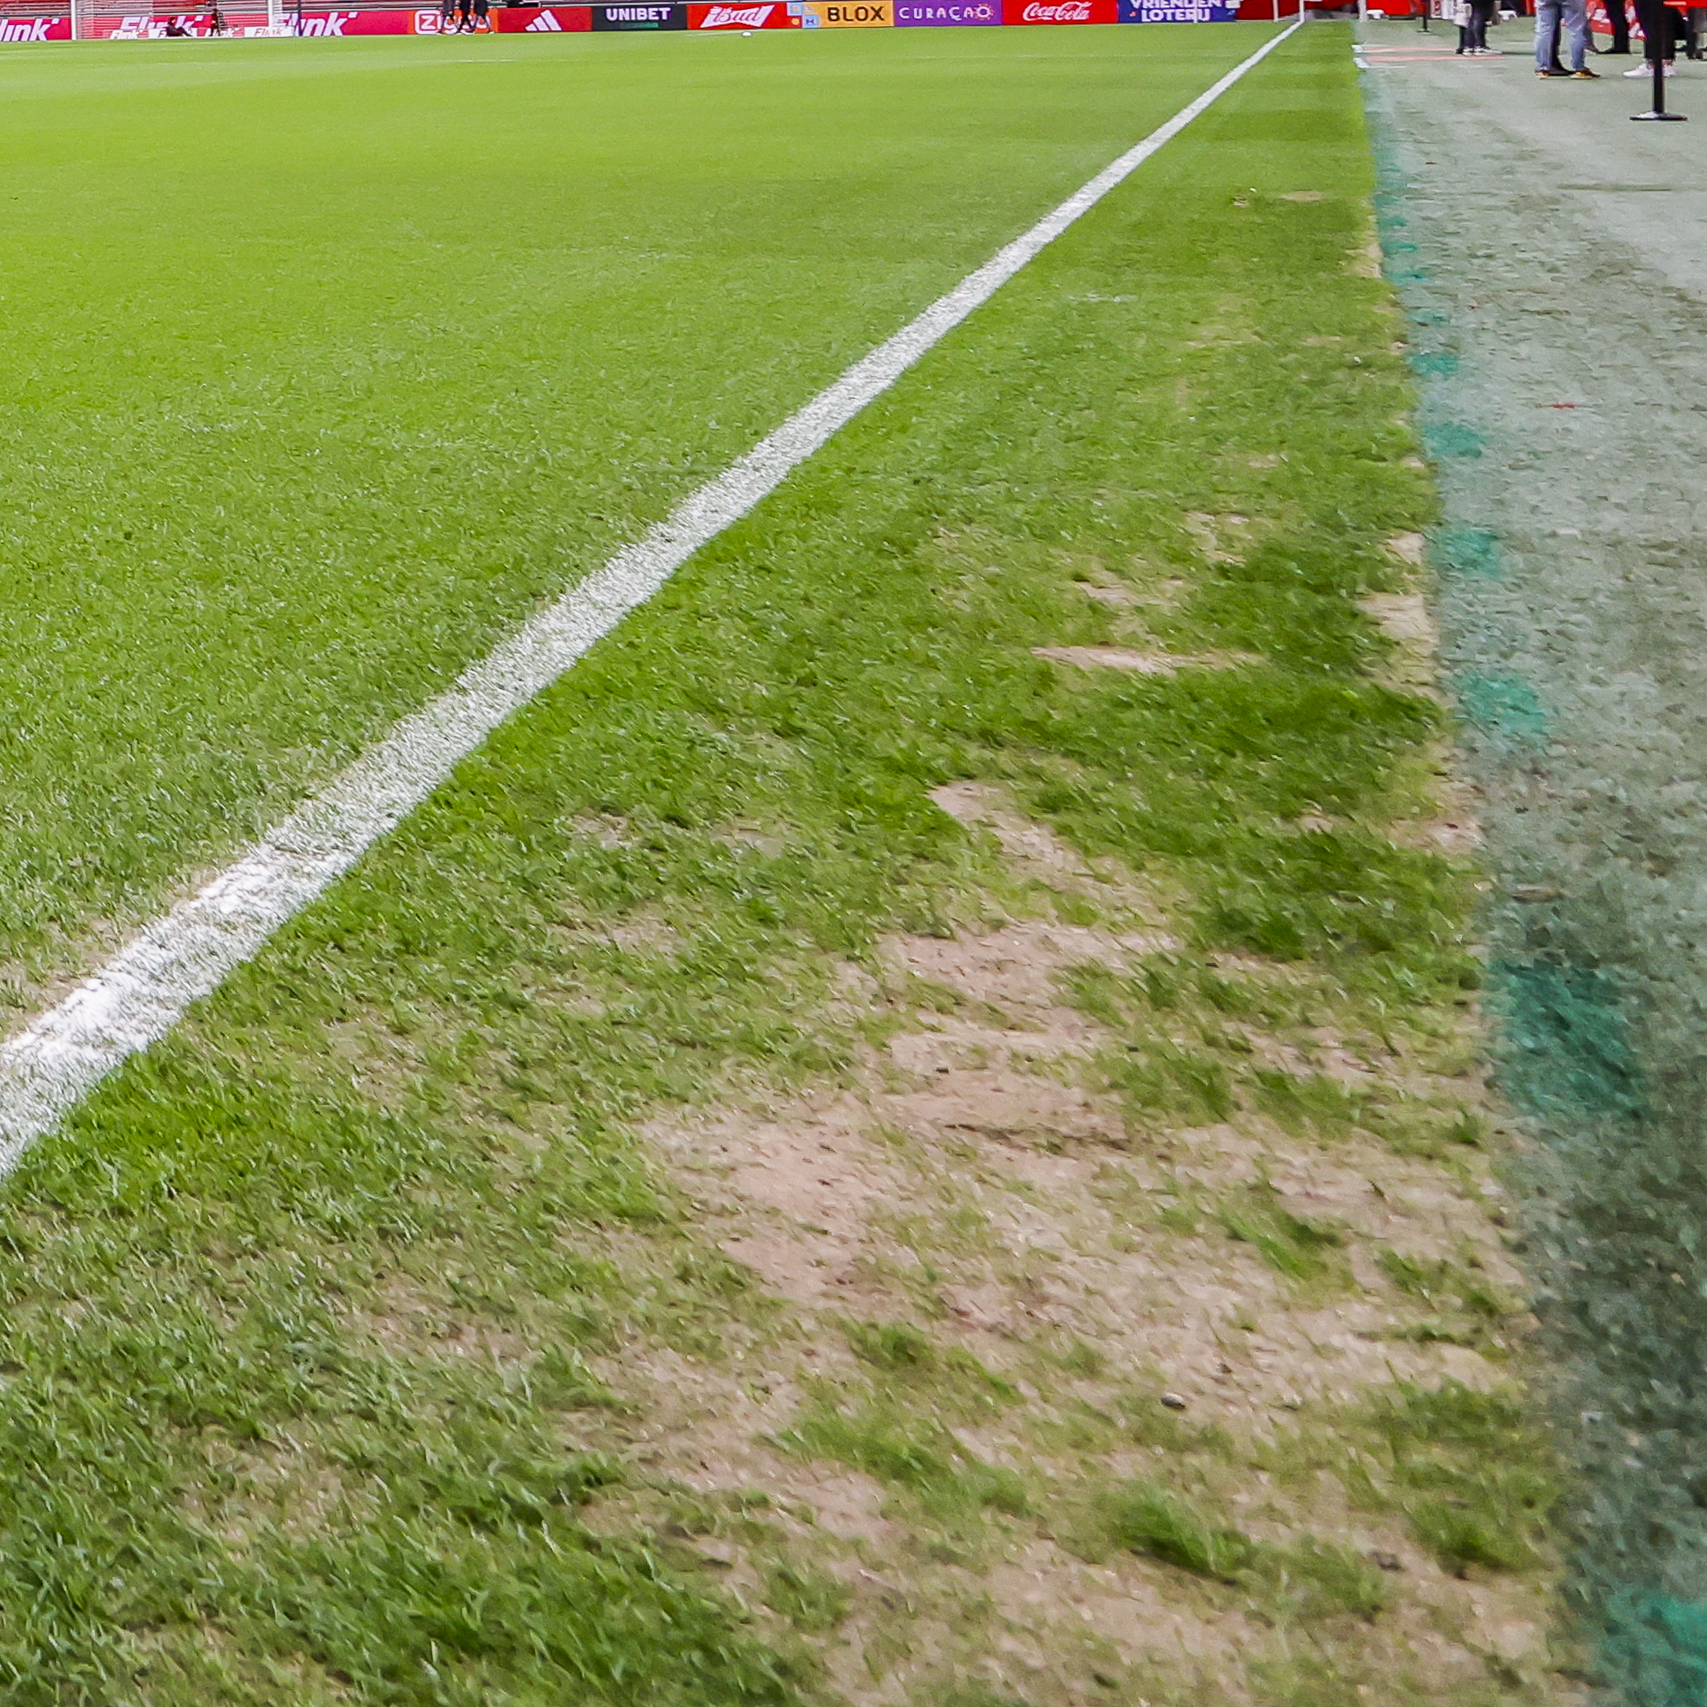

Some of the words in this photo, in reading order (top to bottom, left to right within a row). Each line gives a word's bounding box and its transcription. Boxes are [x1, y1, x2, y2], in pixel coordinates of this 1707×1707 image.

[605, 7, 671, 21] UNIBET
[712, 6, 761, 23] Bud
[827, 5, 885, 22] BLOX
[1023, 1, 1092, 21] Coca-Cola
[415, 9, 491, 34] Zigo
